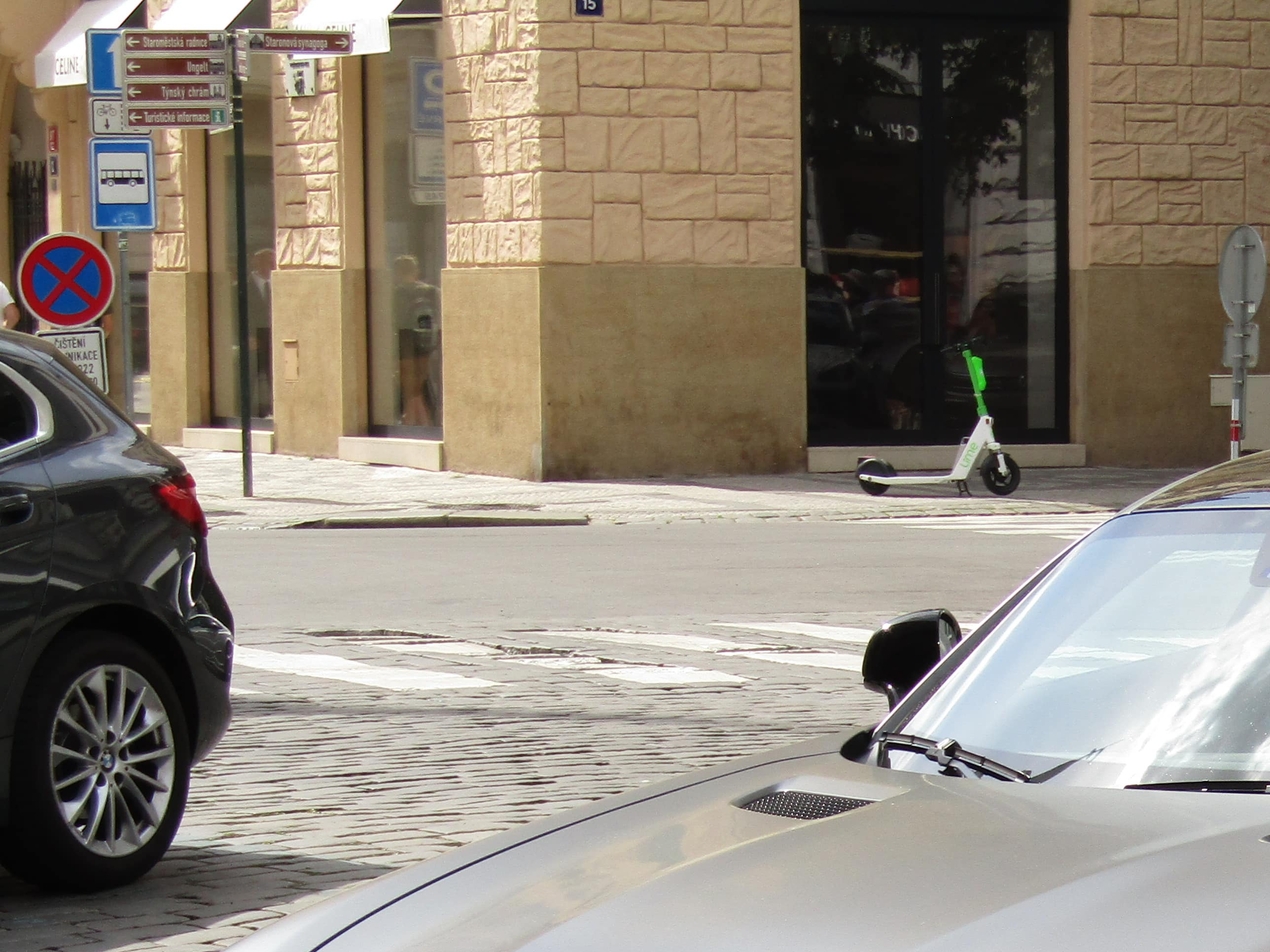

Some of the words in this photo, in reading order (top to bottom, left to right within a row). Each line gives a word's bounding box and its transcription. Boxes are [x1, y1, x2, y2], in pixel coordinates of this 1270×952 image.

[584, 0, 596, 10] 15
[143, 36, 184, 48] Staroměstská
[186, 36, 208, 48] radnice
[265, 36, 298, 48] Staronová
[299, 38, 328, 51] synagoga
[55, 57, 79, 75] CELINE
[187, 61, 209, 75] Ungelt
[162, 85, 186, 99] Týnský
[188, 86, 209, 98] chrám
[144, 111, 175, 123] Turistické
[177, 110, 210, 123] informace
